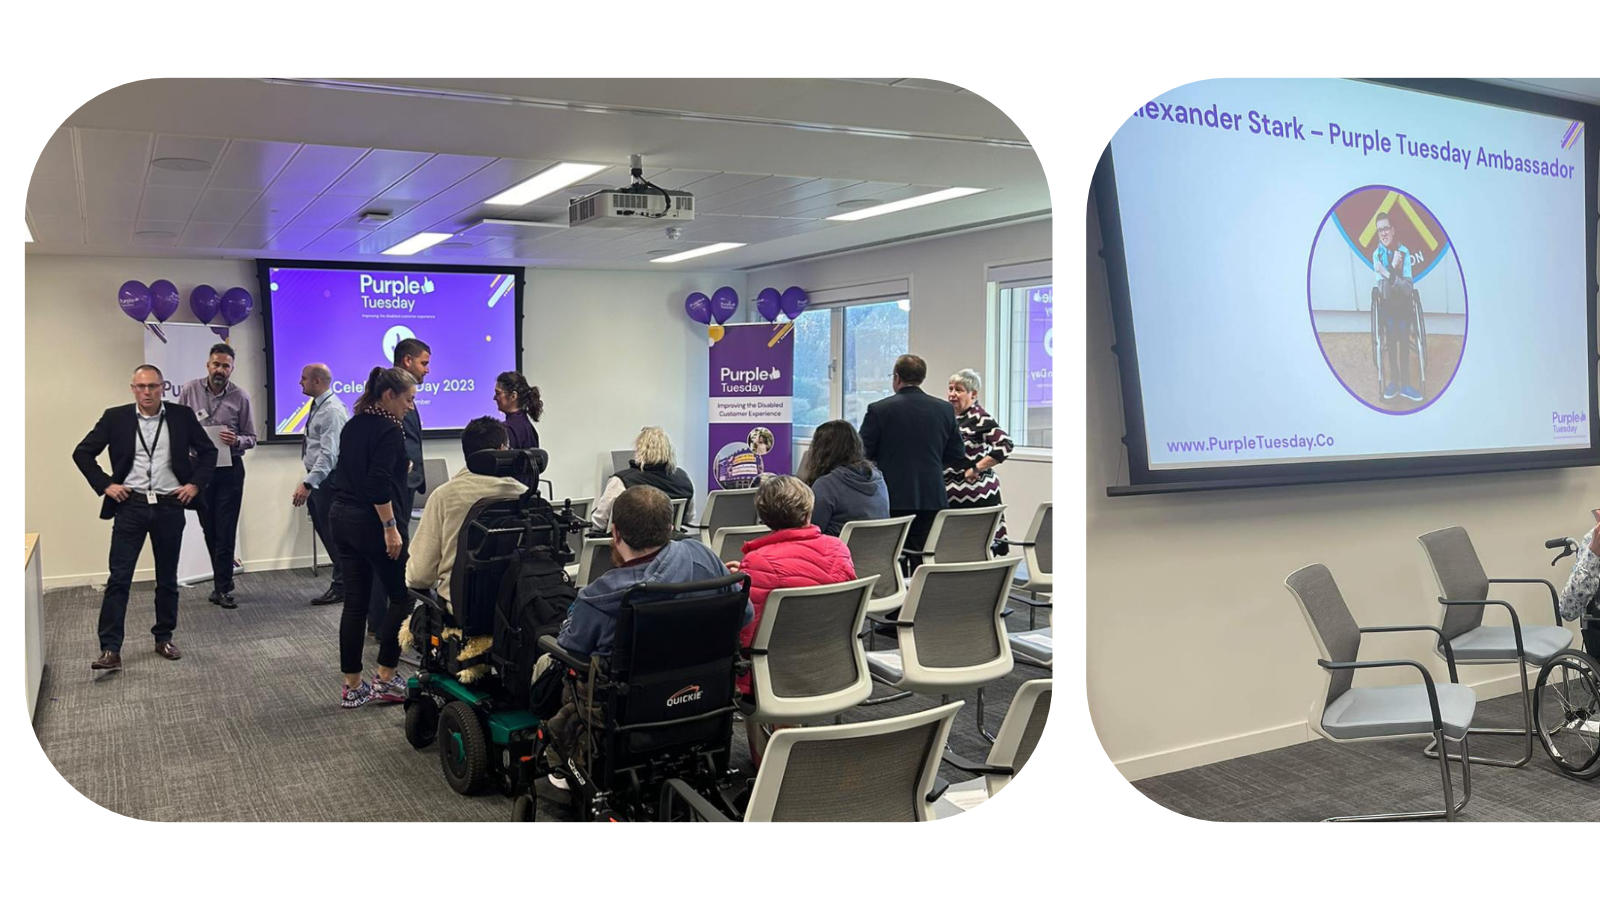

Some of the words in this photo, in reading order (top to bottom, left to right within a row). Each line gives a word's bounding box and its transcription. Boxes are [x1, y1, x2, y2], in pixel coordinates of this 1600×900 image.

[1133, 101, 1242, 131] exander
[1248, 110, 1306, 141] Stark
[1329, 122, 1391, 156] Purple
[1396, 133, 1471, 170] Tuesday
[1476, 146, 1574, 180] Ambassador
[360, 274, 420, 297] Purple
[361, 295, 415, 312] Tuesday
[720, 366, 769, 383] Purple
[443, 379, 475, 392] 2023
[720, 382, 765, 395] Tuesday
[717, 402, 746, 410] Improving
[748, 410, 782, 418] Experience
[1552, 411, 1580, 425] Purple
[1552, 424, 1578, 434] Tuesday
[1166, 433, 1335, 454] www.PurpleTuesday.Co
[666, 691, 702, 707] QUICKIE
